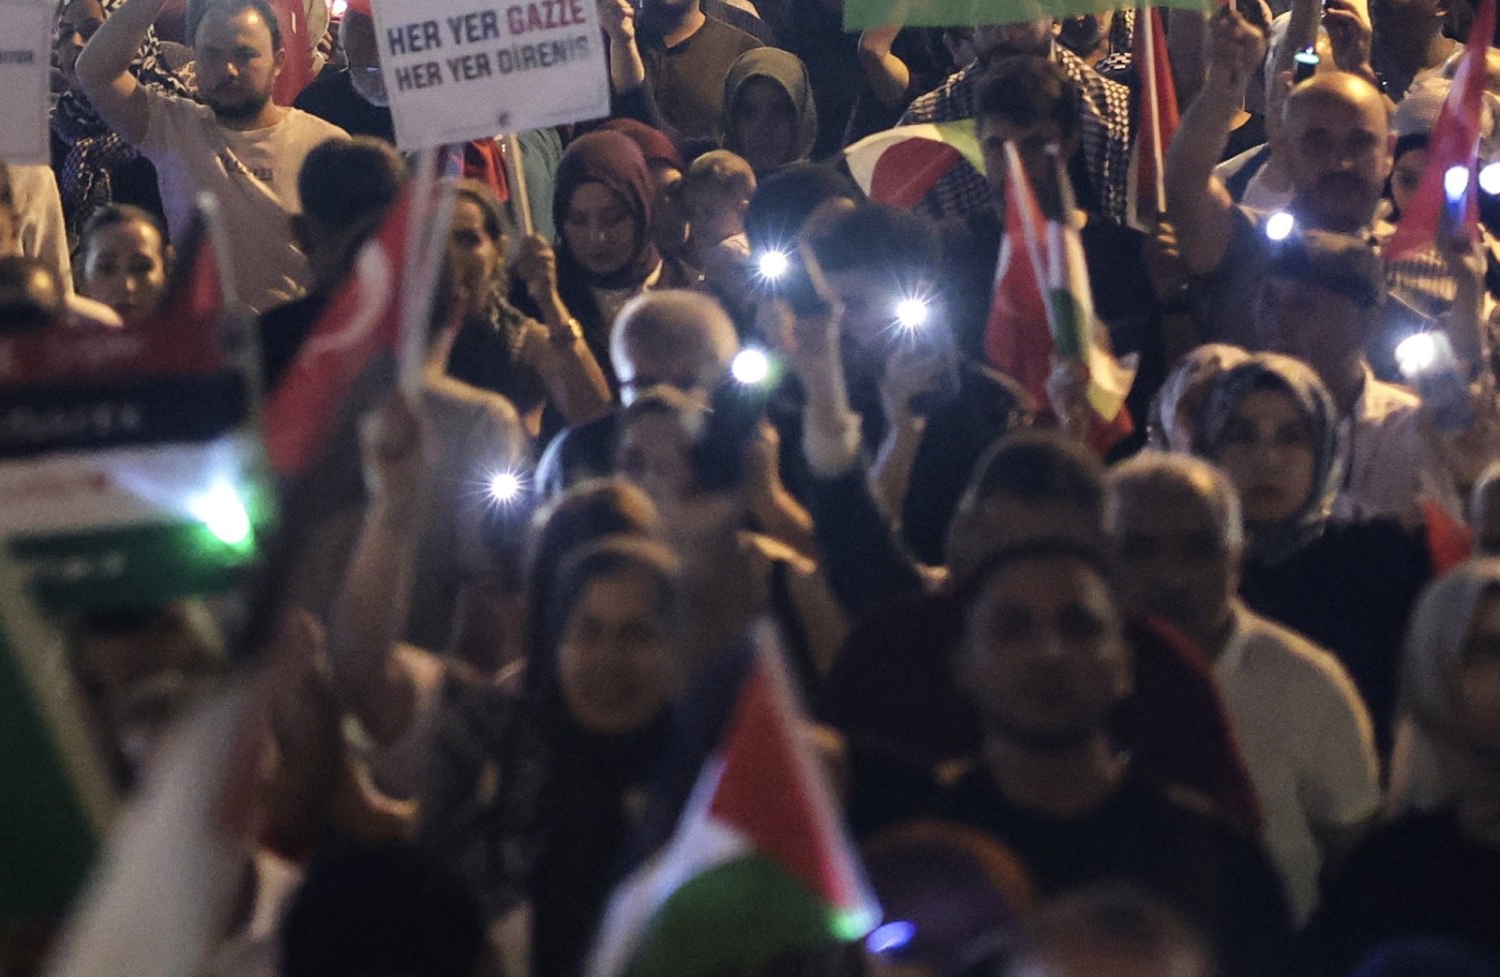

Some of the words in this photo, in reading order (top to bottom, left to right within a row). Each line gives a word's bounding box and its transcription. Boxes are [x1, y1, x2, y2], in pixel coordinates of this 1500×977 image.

[386, 20, 443, 57] HER
[446, 9, 500, 46] YER
[394, 61, 444, 91] HER
[446, 52, 493, 83] YER
